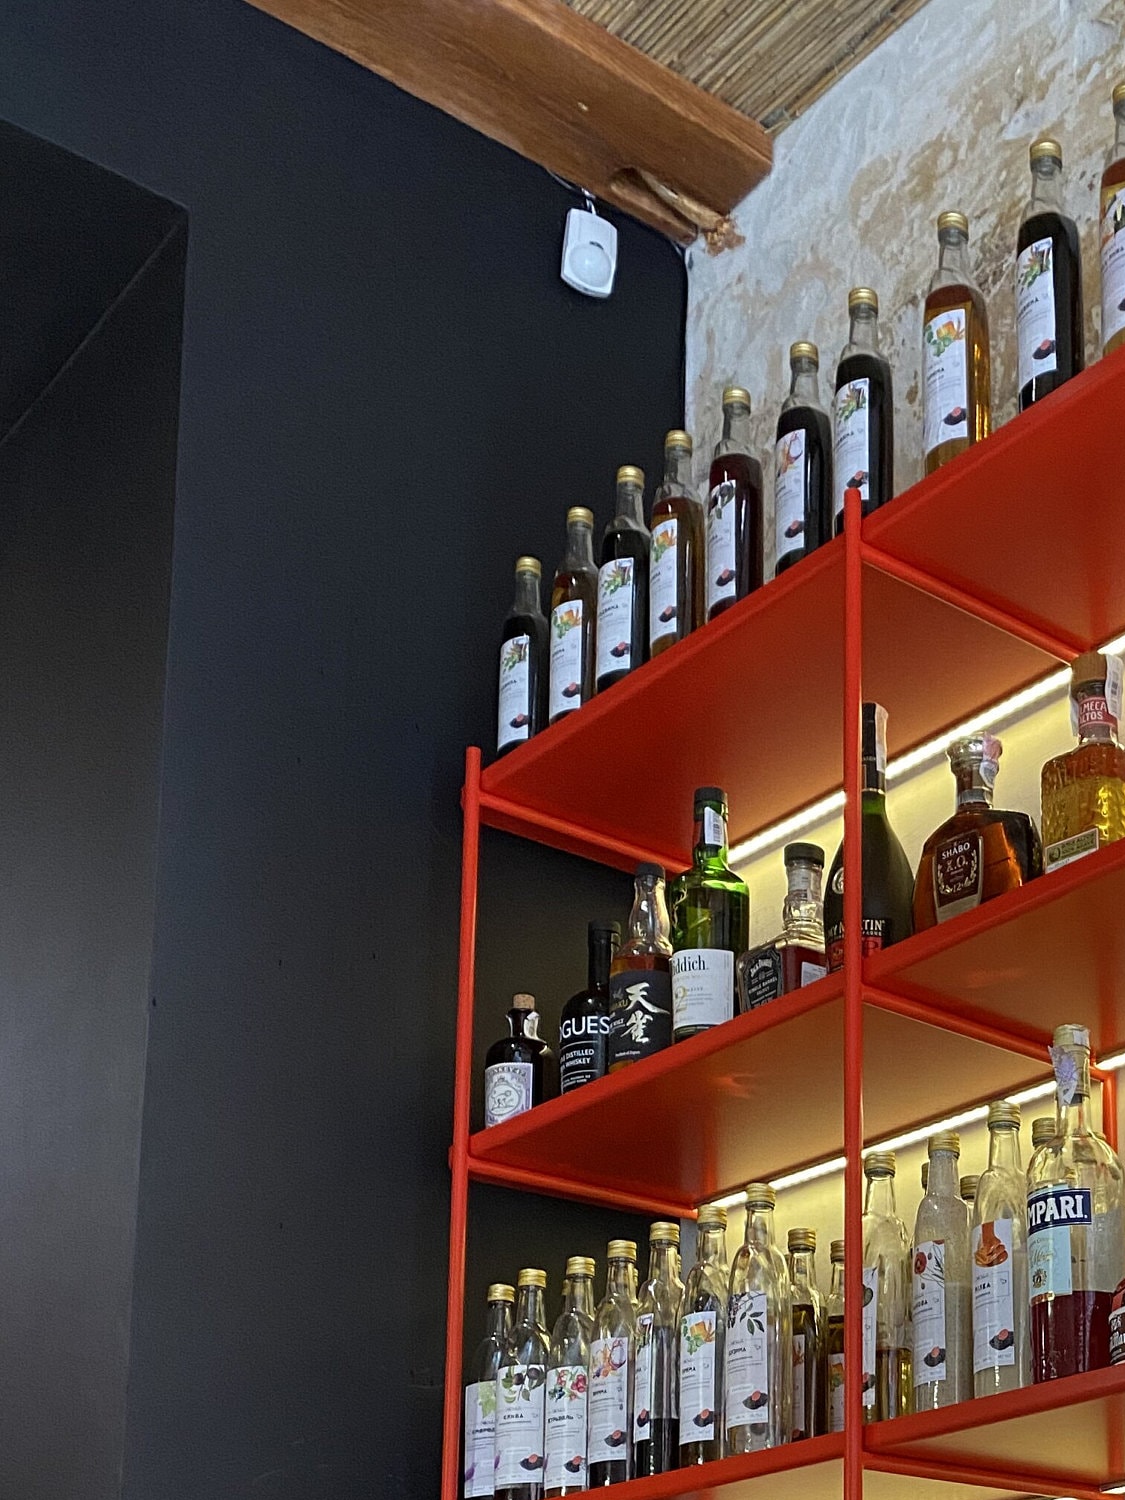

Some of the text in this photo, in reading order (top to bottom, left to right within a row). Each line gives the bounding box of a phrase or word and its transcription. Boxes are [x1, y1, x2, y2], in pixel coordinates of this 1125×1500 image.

[942, 842, 970, 860] SHABO
[561, 1015, 611, 1039] GUES
[566, 1049, 595, 1060] DISTILLED
[1028, 1194, 1088, 1228] MPARI.
